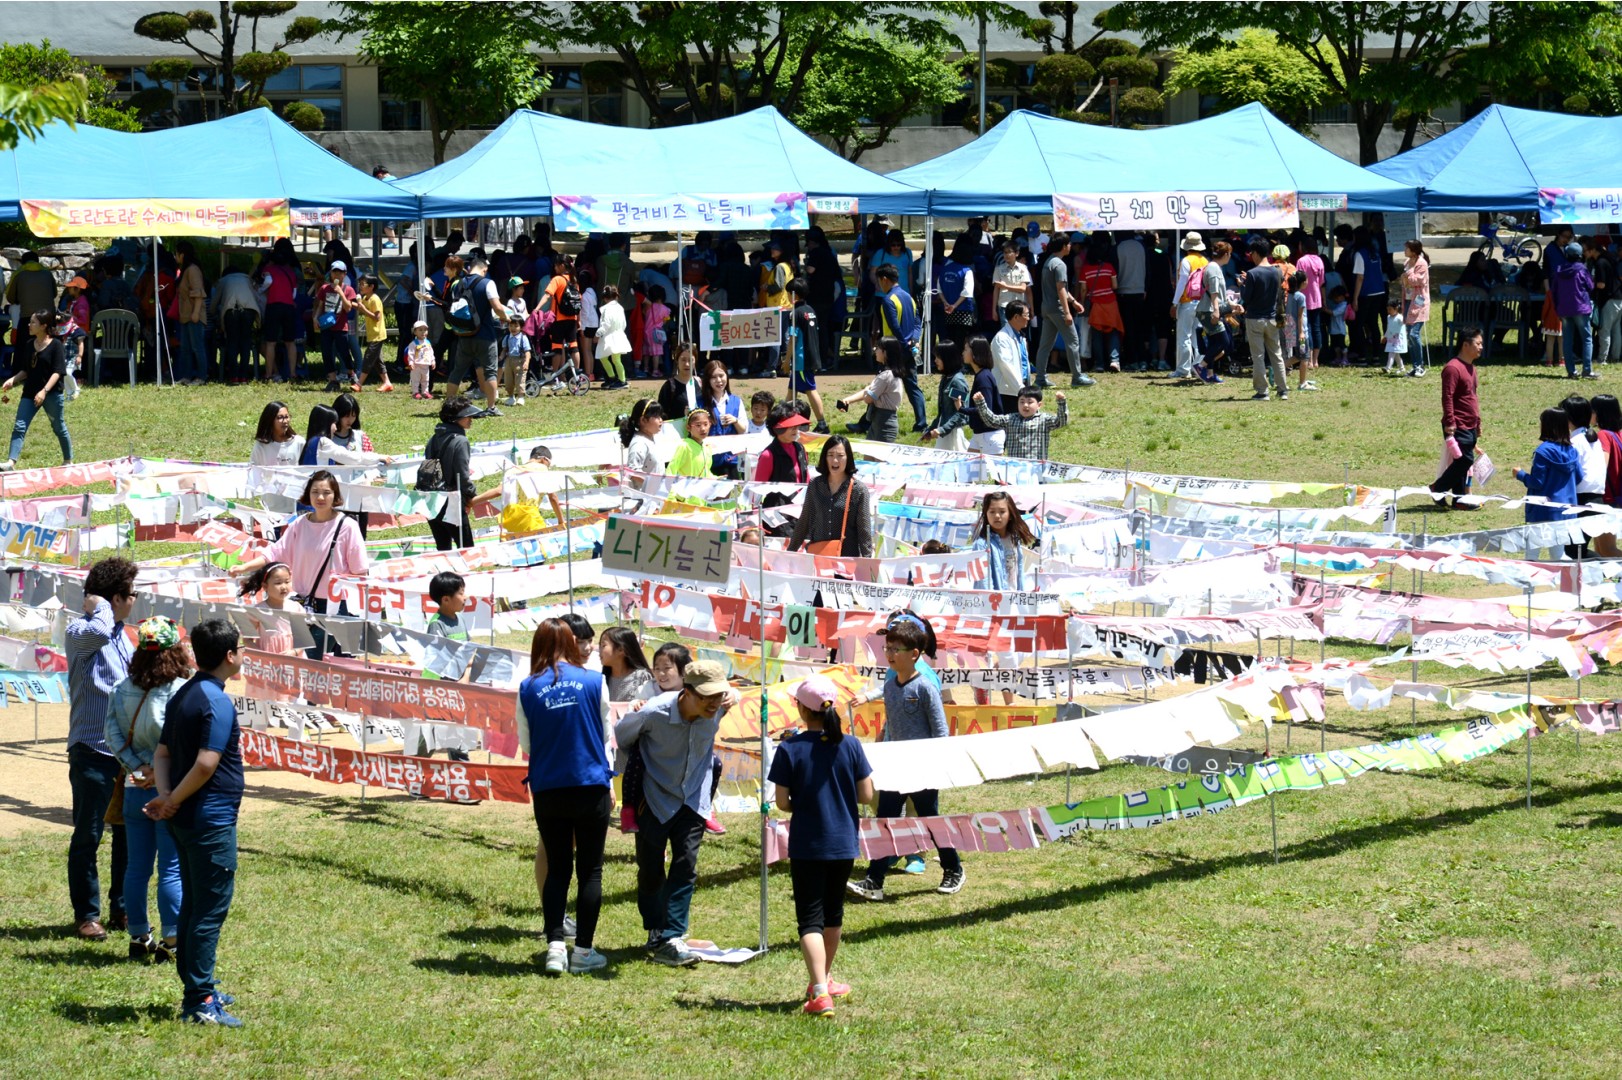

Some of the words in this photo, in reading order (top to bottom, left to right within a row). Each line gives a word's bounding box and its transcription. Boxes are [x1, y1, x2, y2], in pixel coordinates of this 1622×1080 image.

[612, 202, 688, 225] 펄러비즈
[697, 199, 754, 225] 만들기
[1589, 193, 1620, 215] 비밀
[68, 208, 138, 227] 도란도란
[142, 207, 191, 226] 수세미
[195, 207, 248, 229] 만들기
[536, 680, 584, 699] 느티나무도서관
[349, 753, 425, 792] 산재보험
[430, 763, 471, 801] 적용
